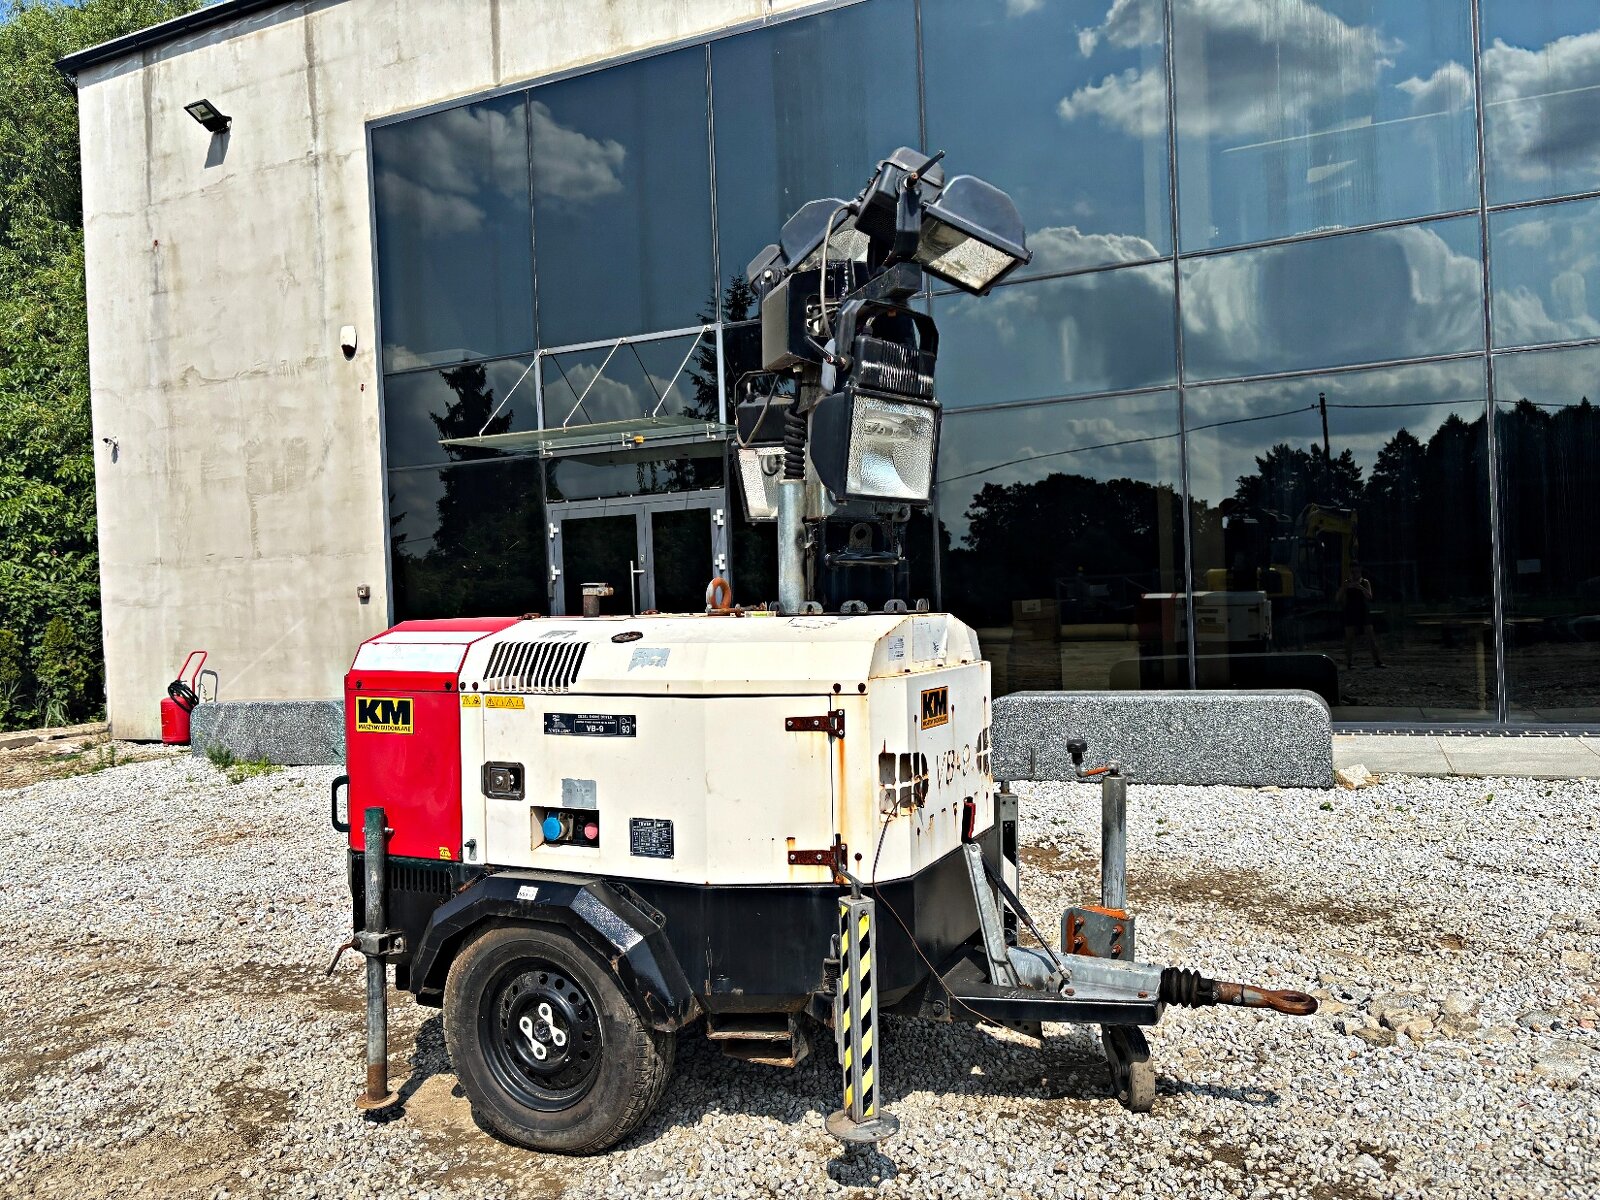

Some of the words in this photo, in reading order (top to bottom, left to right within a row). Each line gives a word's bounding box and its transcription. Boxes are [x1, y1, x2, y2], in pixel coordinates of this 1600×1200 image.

[358, 699, 410, 725] KM
[922, 691, 947, 719] KM
[621, 726, 630, 734] 93
